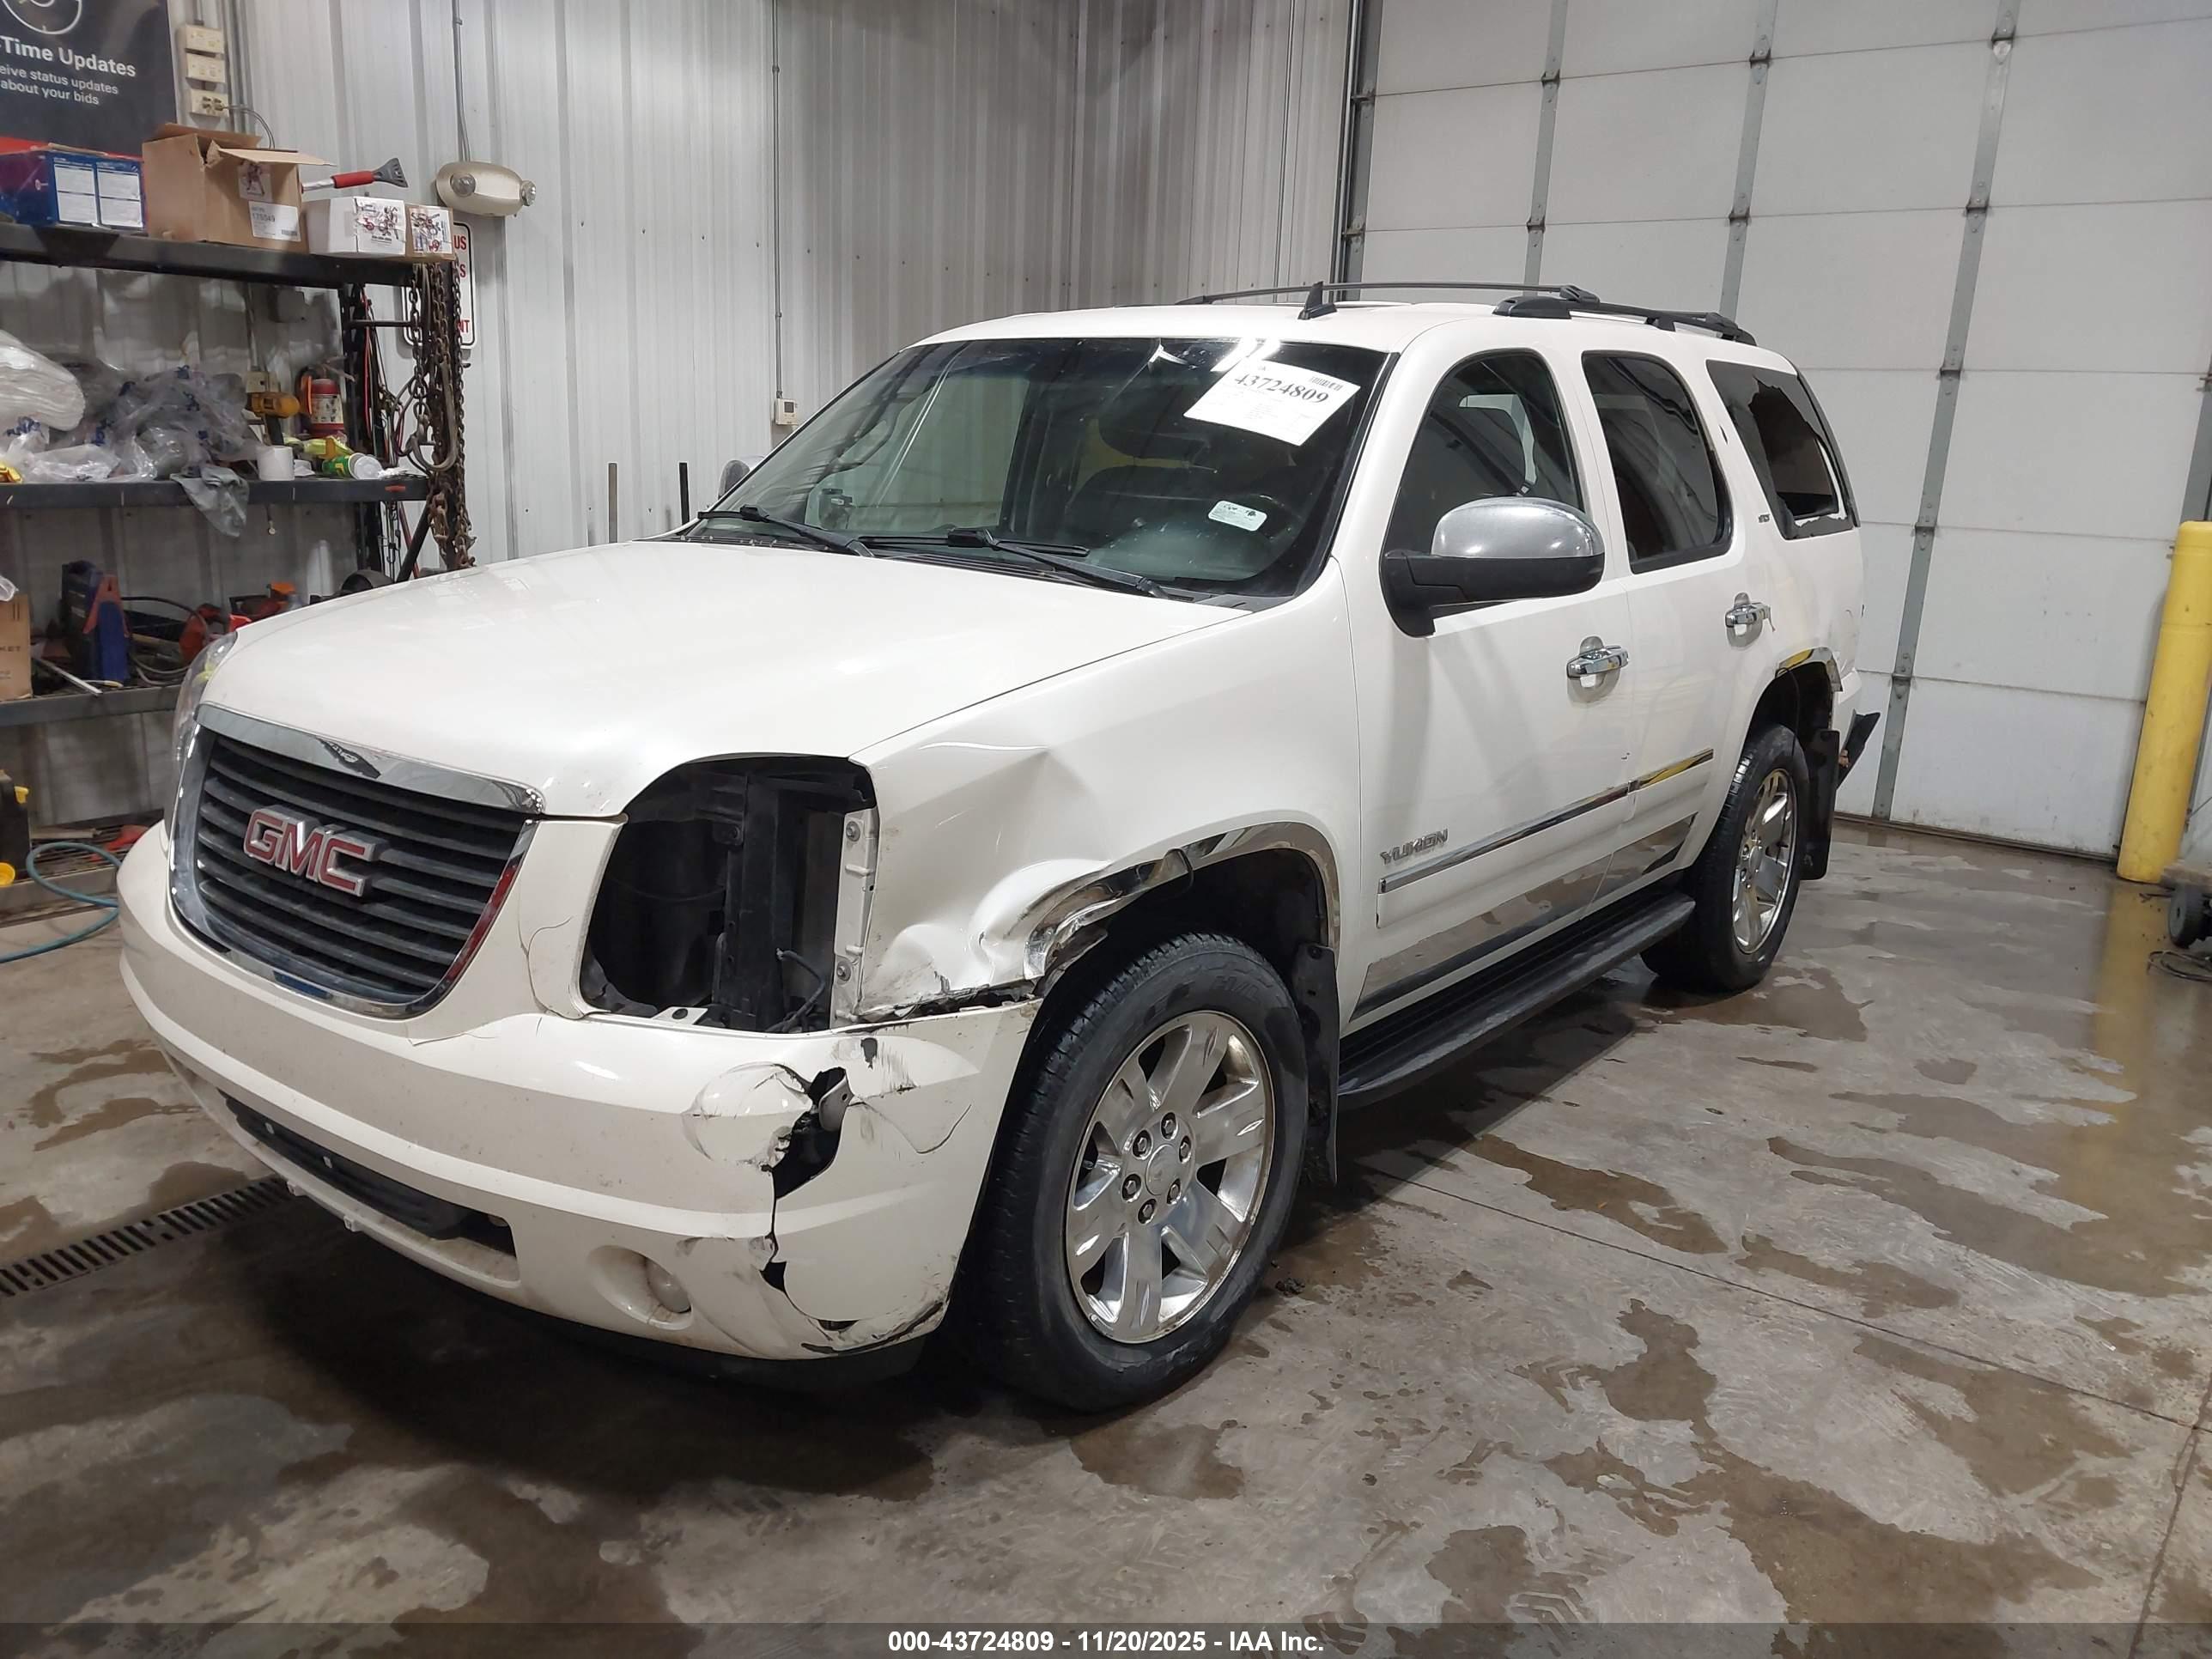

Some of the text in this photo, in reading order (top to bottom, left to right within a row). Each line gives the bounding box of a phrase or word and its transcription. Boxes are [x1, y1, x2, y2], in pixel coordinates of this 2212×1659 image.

[58, 47, 137, 77] Updates
[1, 79, 100, 105] about your bids
[30, 70, 69, 86] status
[71, 78, 119, 94] updates
[1234, 374, 1329, 403] 43724809
[243, 806, 384, 898] GMC
[1379, 828, 1449, 866] YUKON
